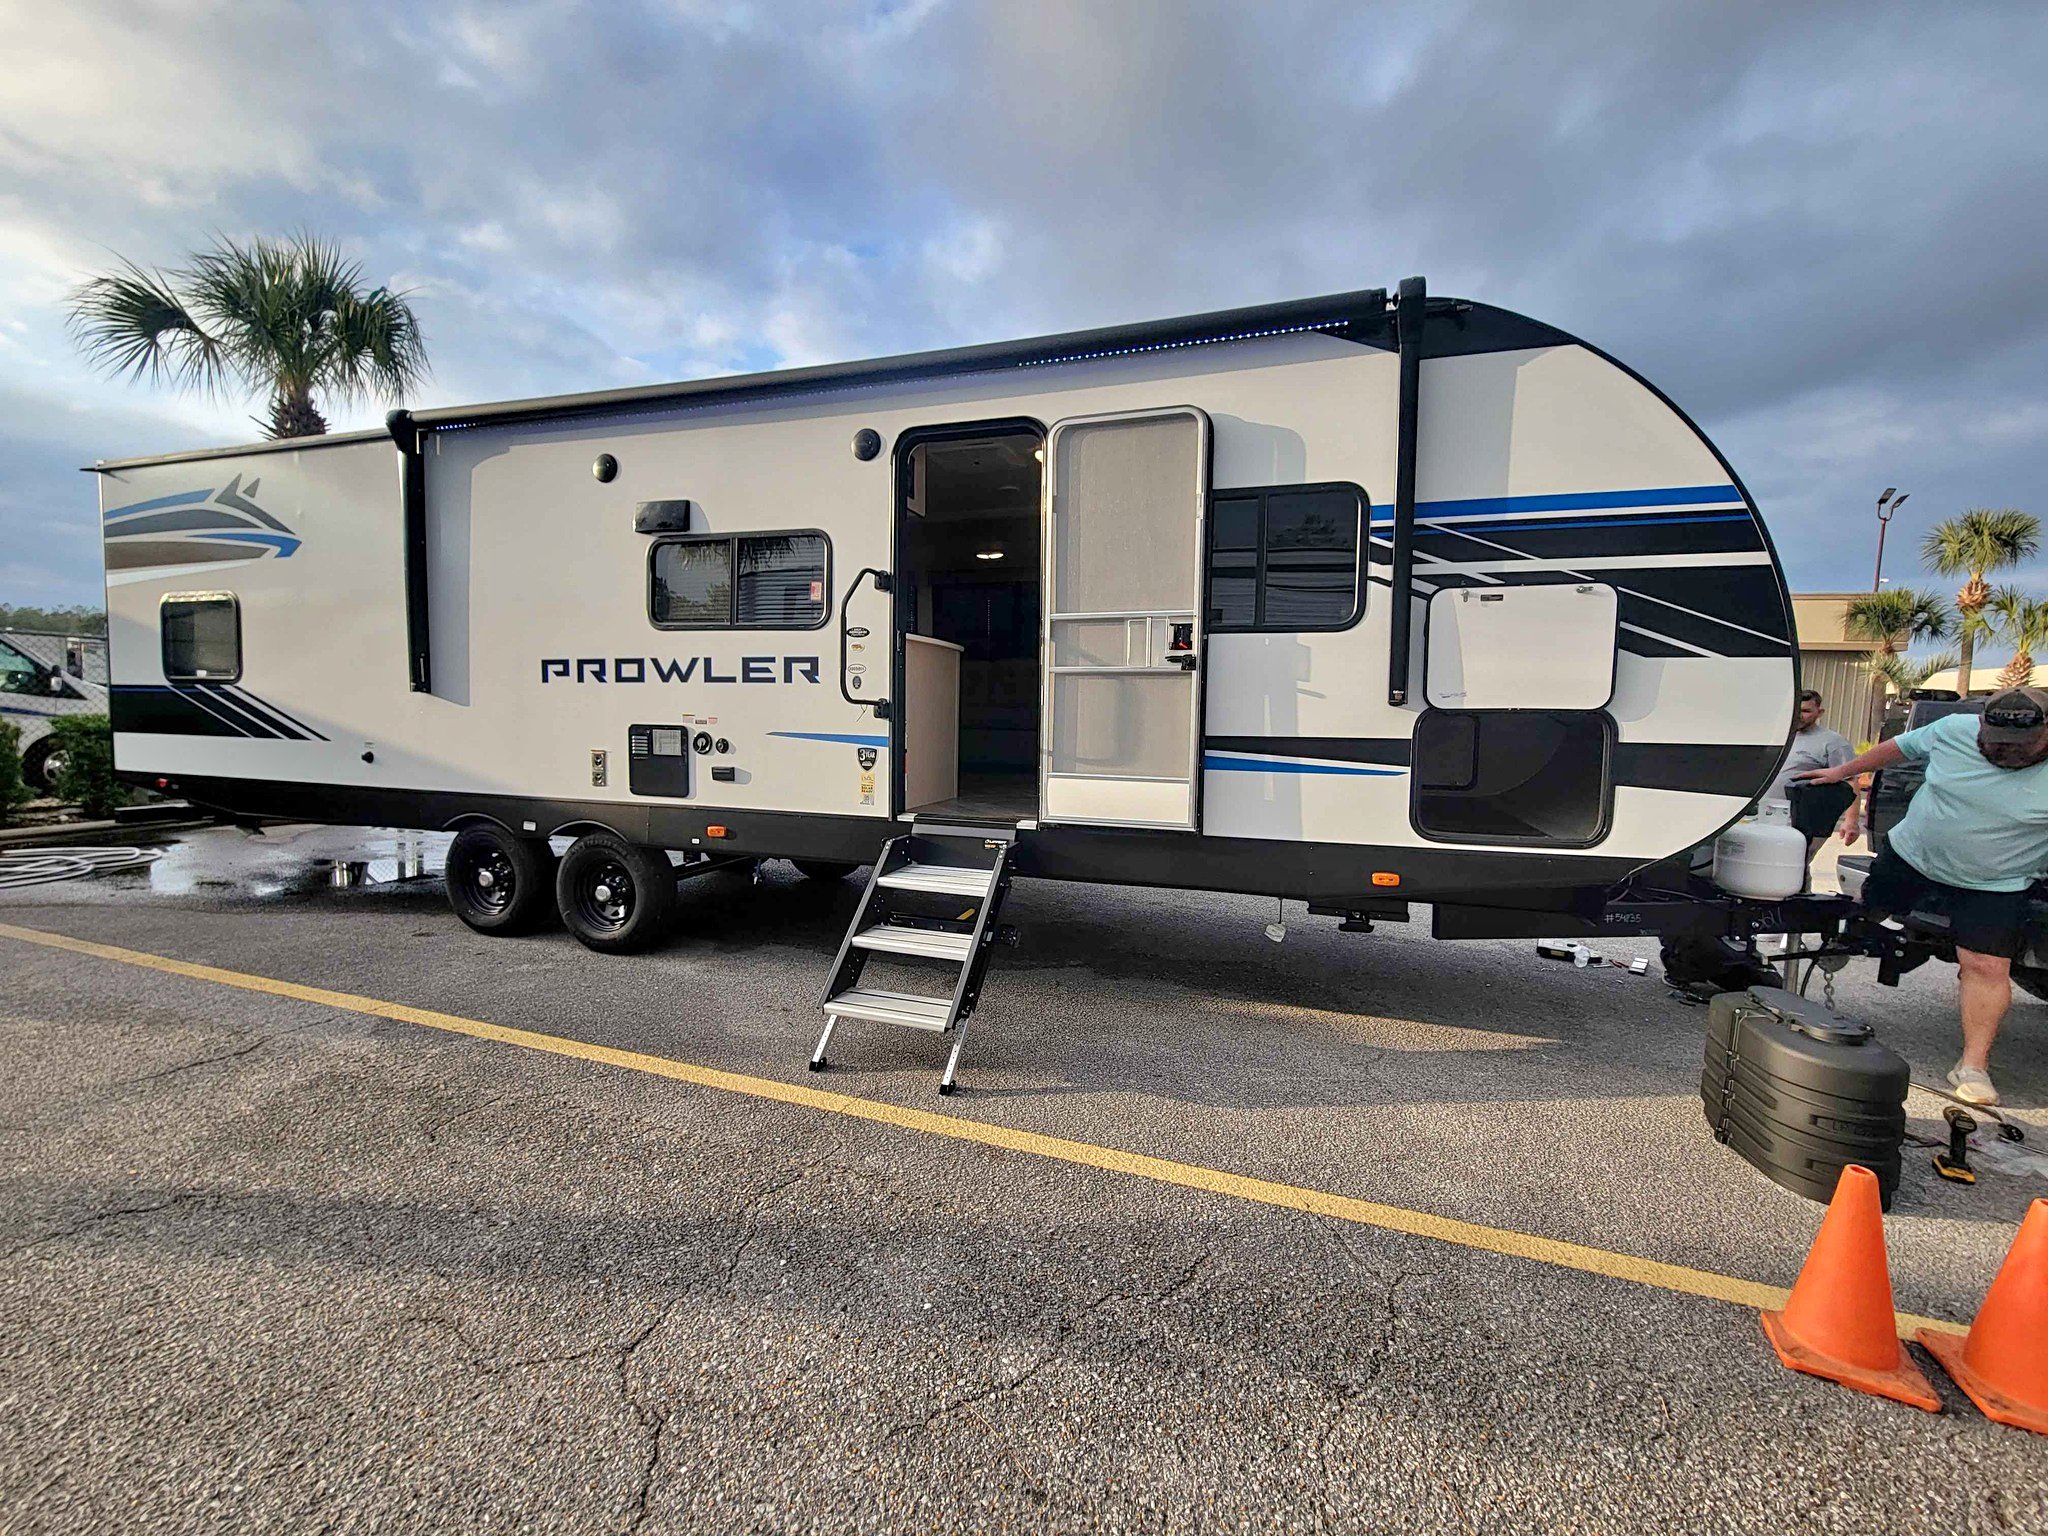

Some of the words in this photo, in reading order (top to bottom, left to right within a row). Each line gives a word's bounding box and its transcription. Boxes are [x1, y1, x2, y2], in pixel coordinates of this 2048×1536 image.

[541, 656, 821, 684] PROWLER
[859, 749, 866, 761] 3
[865, 750, 876, 759] YEAR
